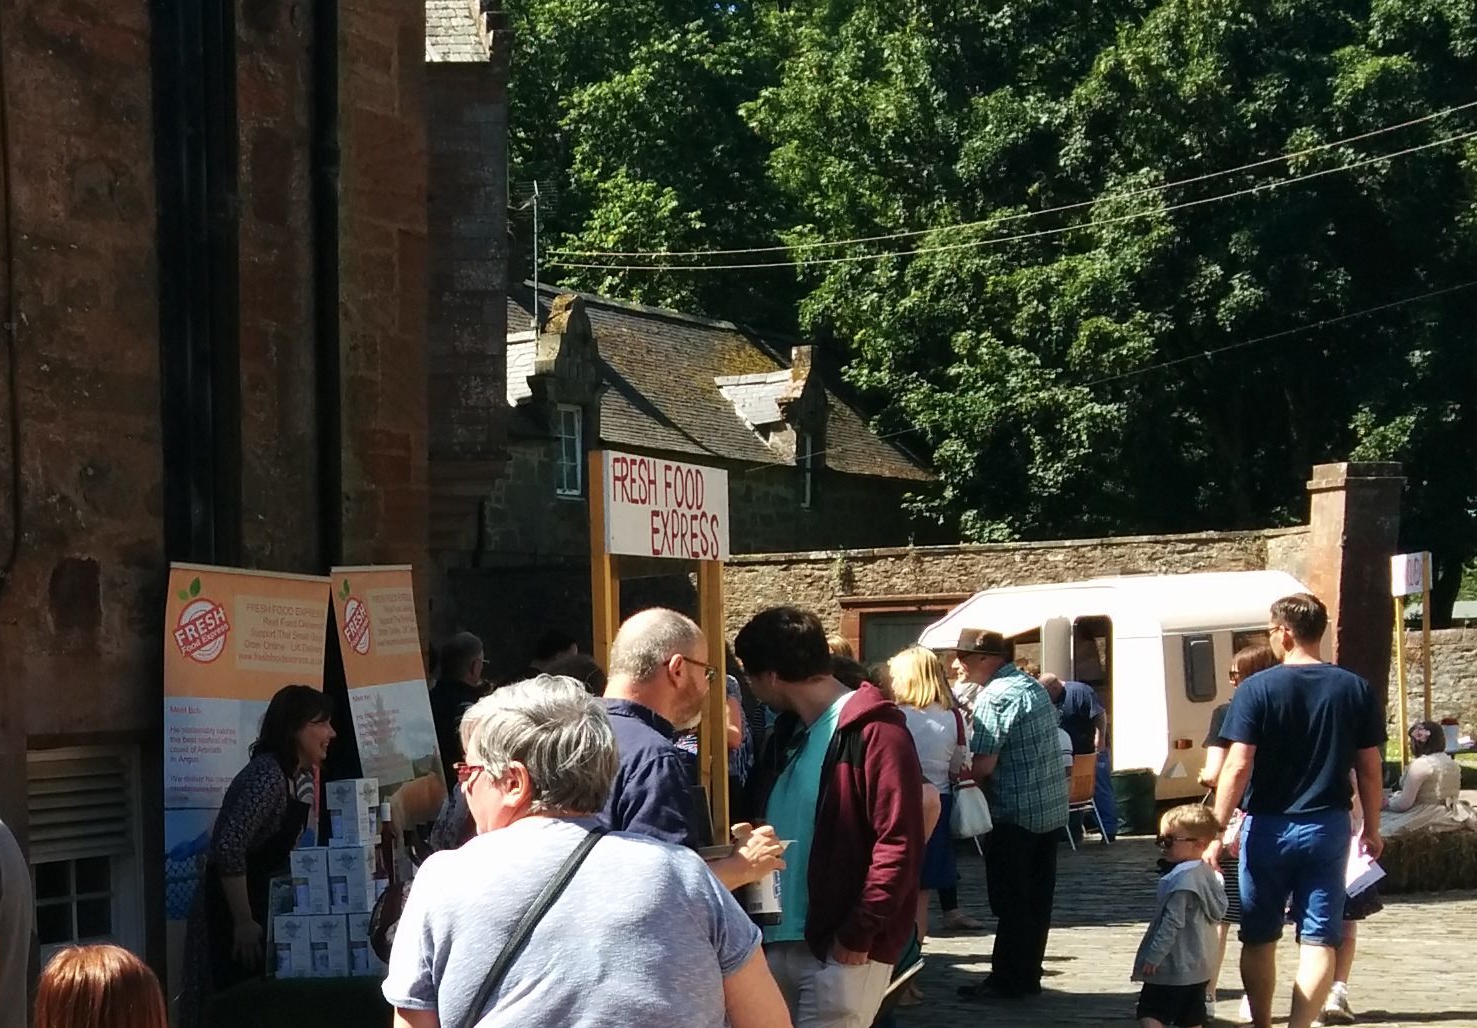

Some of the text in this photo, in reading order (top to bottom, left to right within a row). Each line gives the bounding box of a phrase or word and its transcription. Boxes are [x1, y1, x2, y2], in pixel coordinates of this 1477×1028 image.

[612, 456, 704, 511] FRESH FOOD
[651, 509, 720, 560] EXPRESS
[174, 607, 226, 646] FRESH
[344, 603, 367, 642] FRESH
[181, 638, 201, 657] Food
